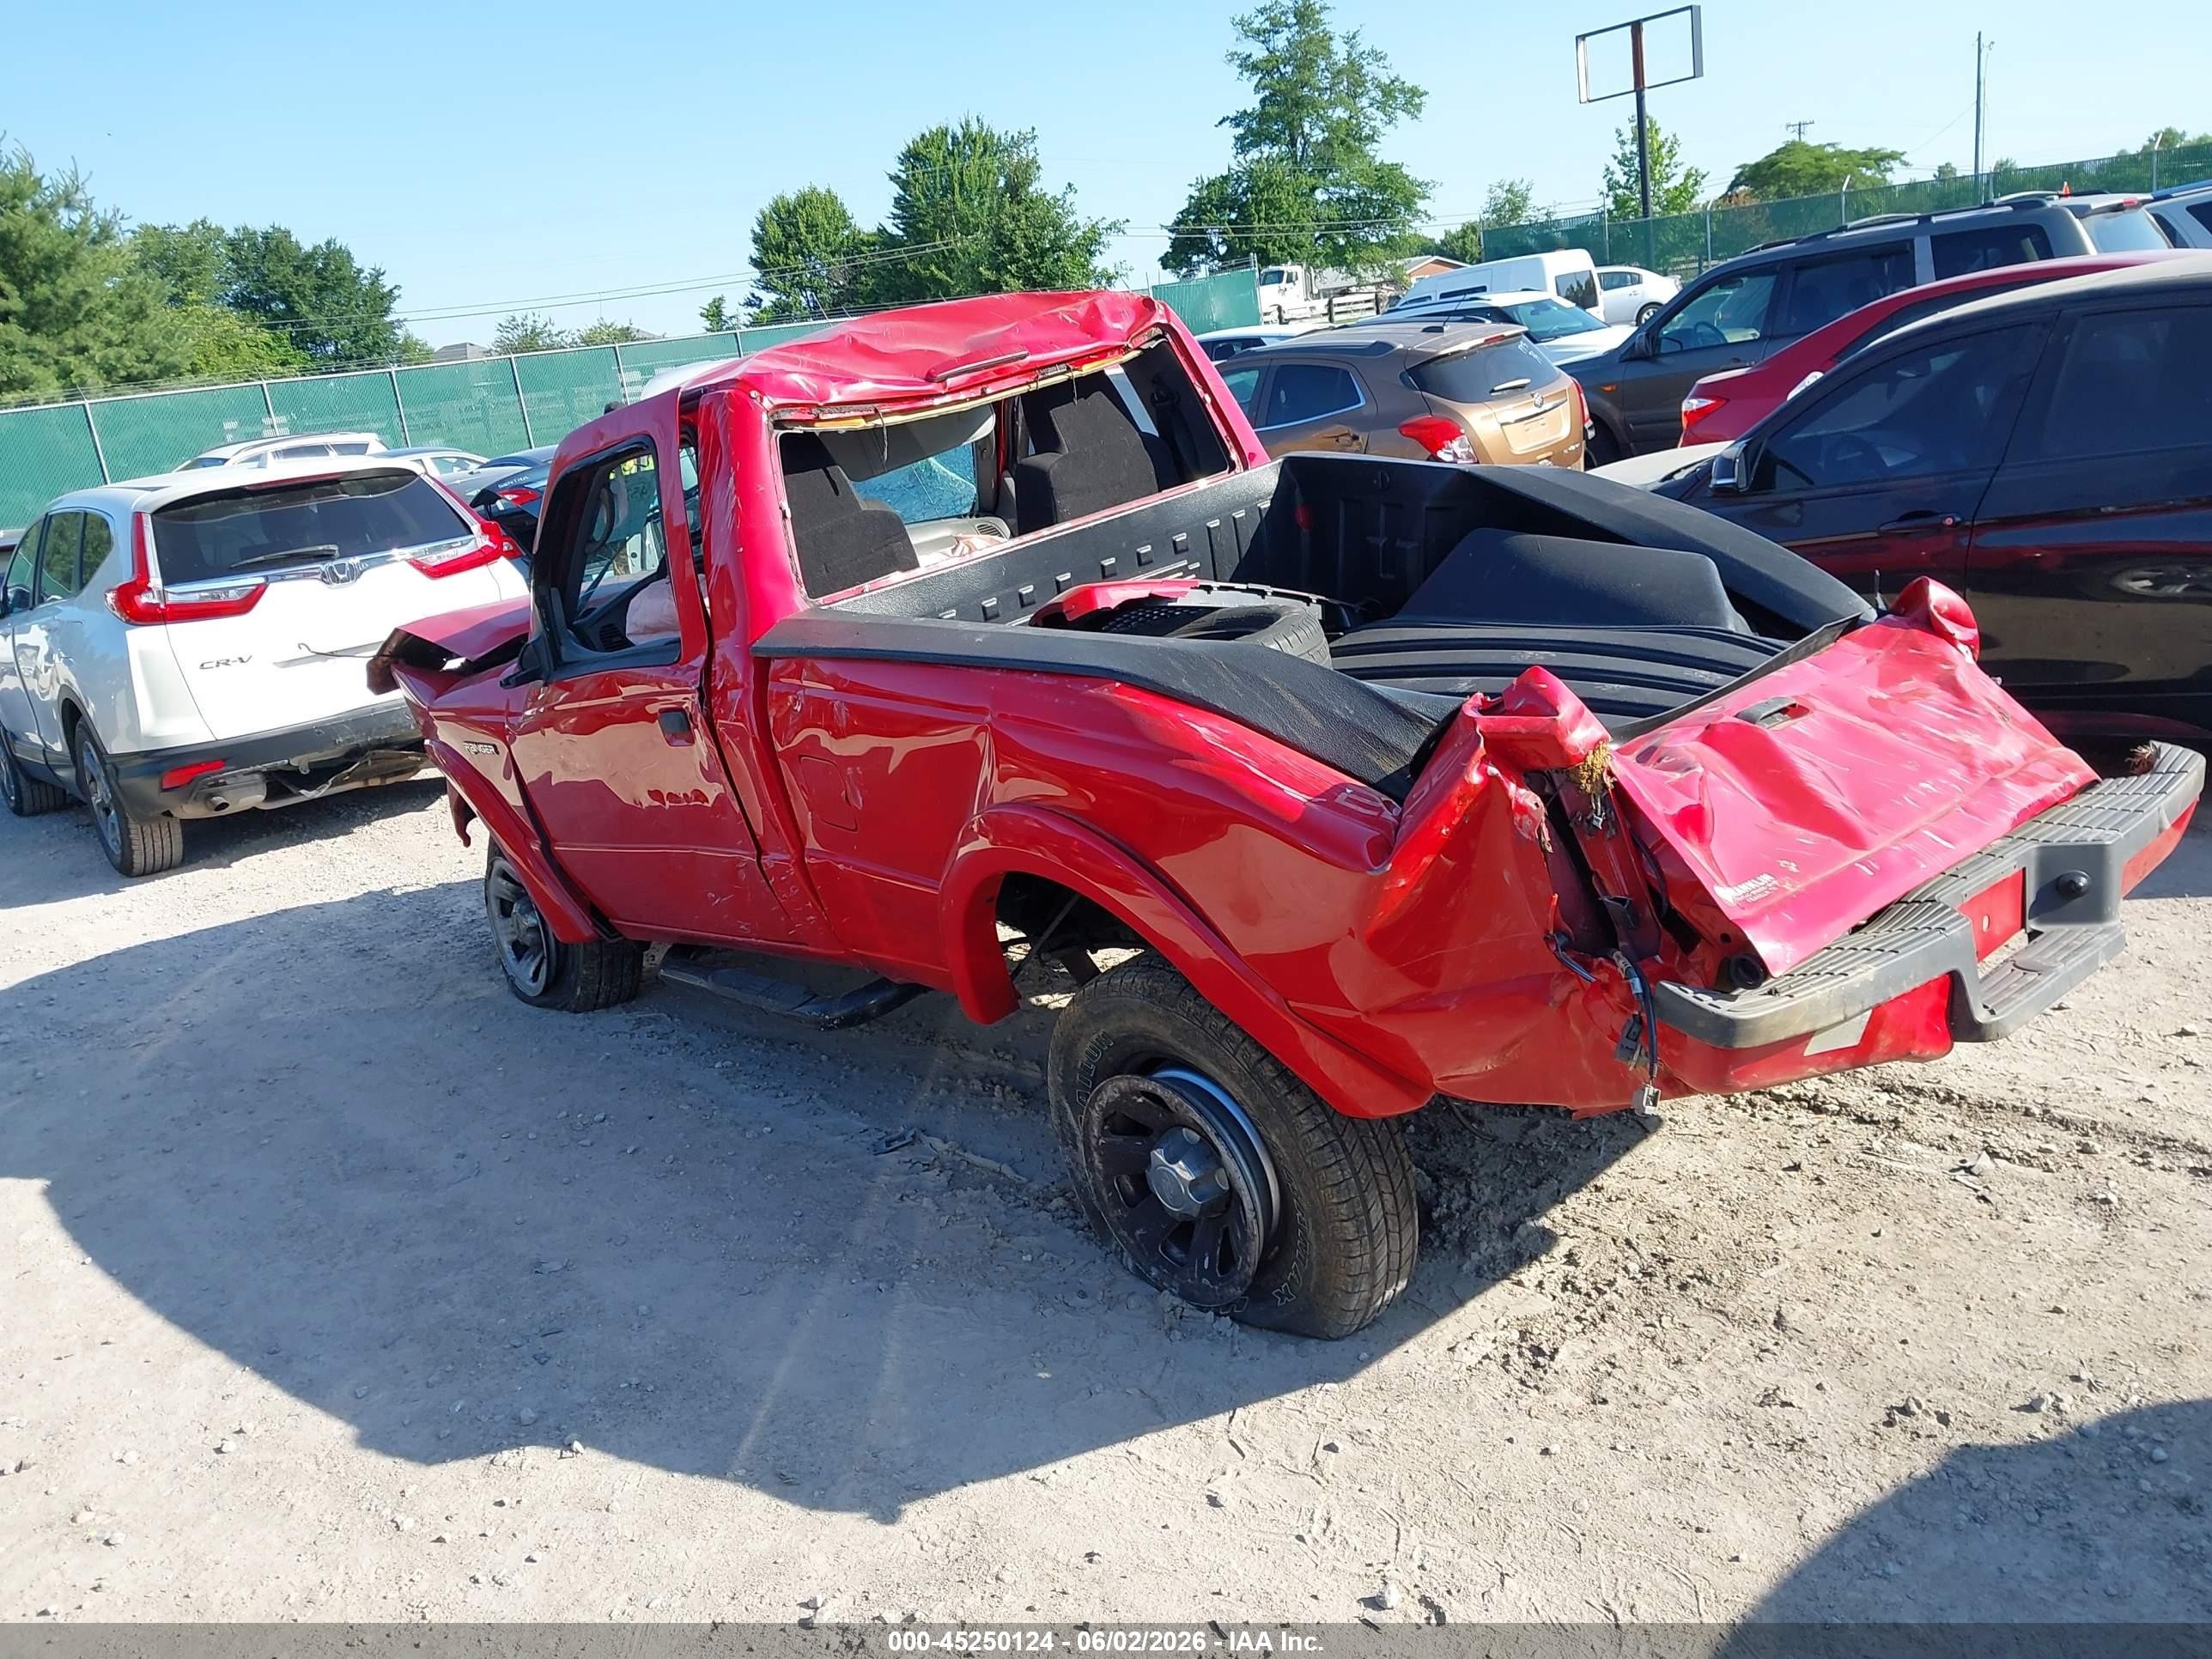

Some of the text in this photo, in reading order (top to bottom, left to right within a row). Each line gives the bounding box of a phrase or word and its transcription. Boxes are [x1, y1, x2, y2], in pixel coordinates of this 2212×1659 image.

[198, 654, 252, 670] CR-V
[463, 742, 497, 755] RANGER
[1075, 1030, 1115, 1129] AILUN
